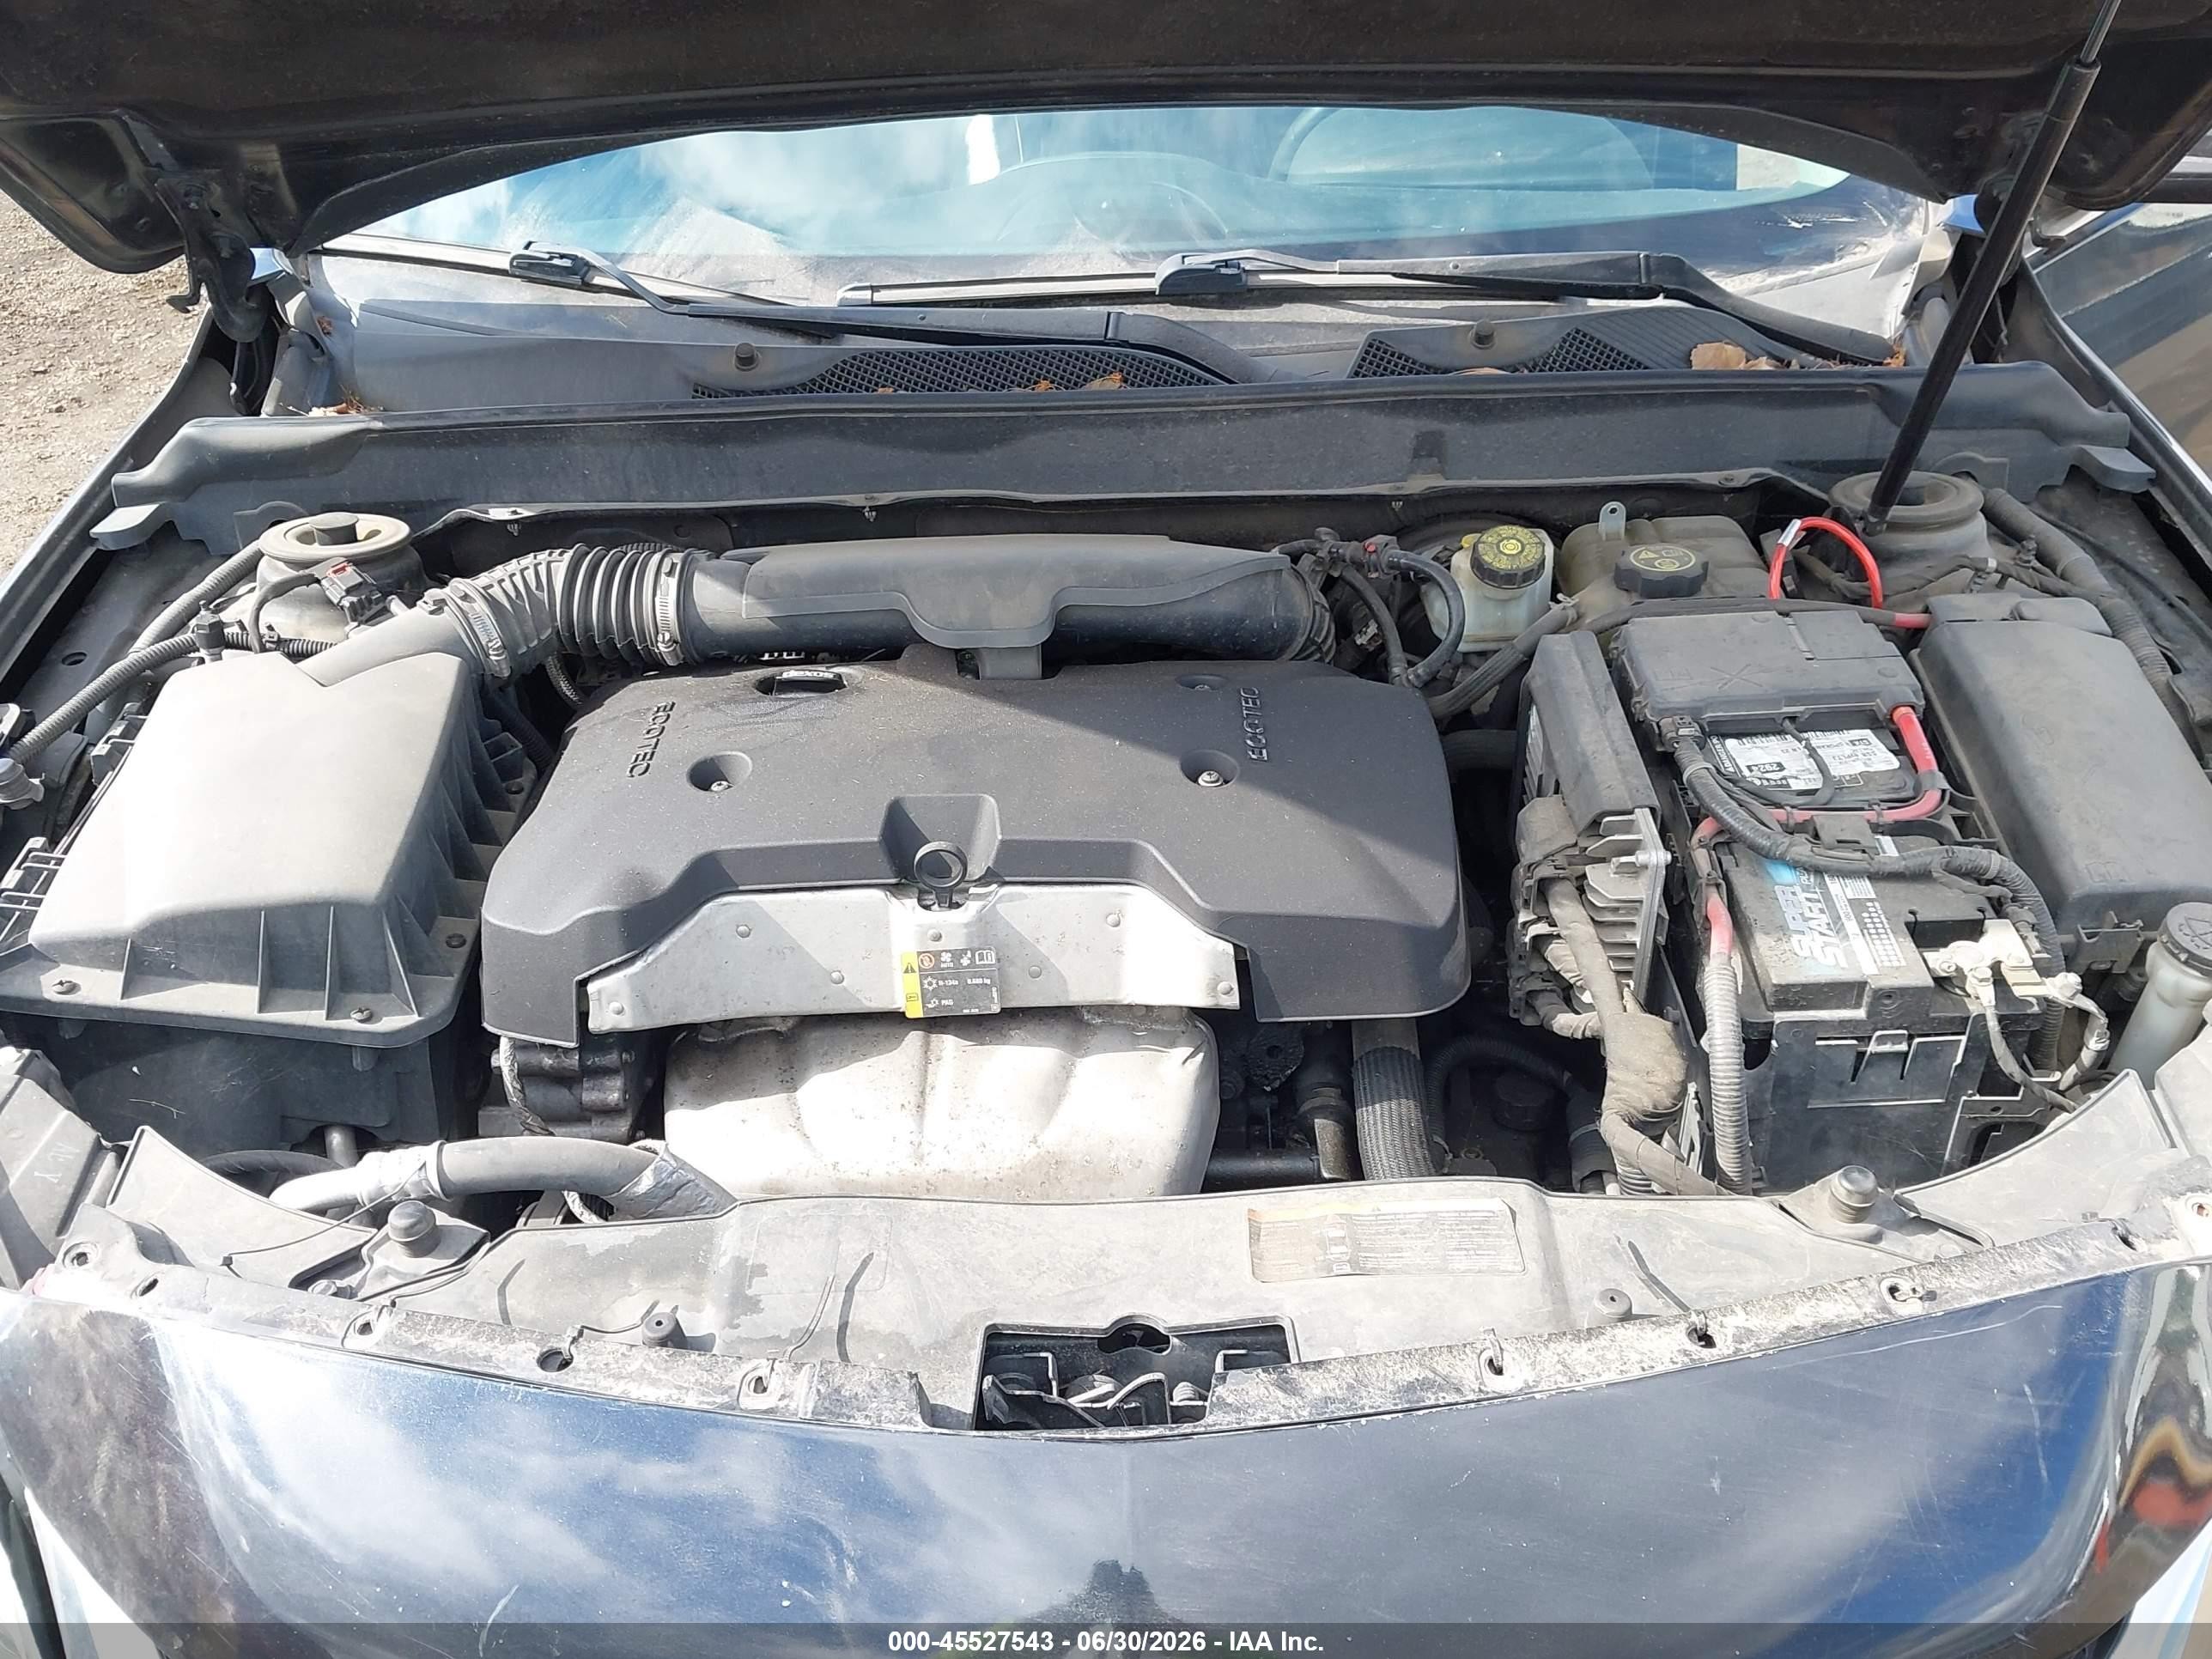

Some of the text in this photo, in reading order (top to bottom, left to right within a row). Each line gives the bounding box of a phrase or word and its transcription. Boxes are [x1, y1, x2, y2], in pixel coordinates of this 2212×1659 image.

[627, 702, 676, 778] ECOTEC
[1240, 686, 1268, 762] ECOTEC
[1774, 884, 1814, 957] SUPER
[1801, 890, 1849, 969] START
